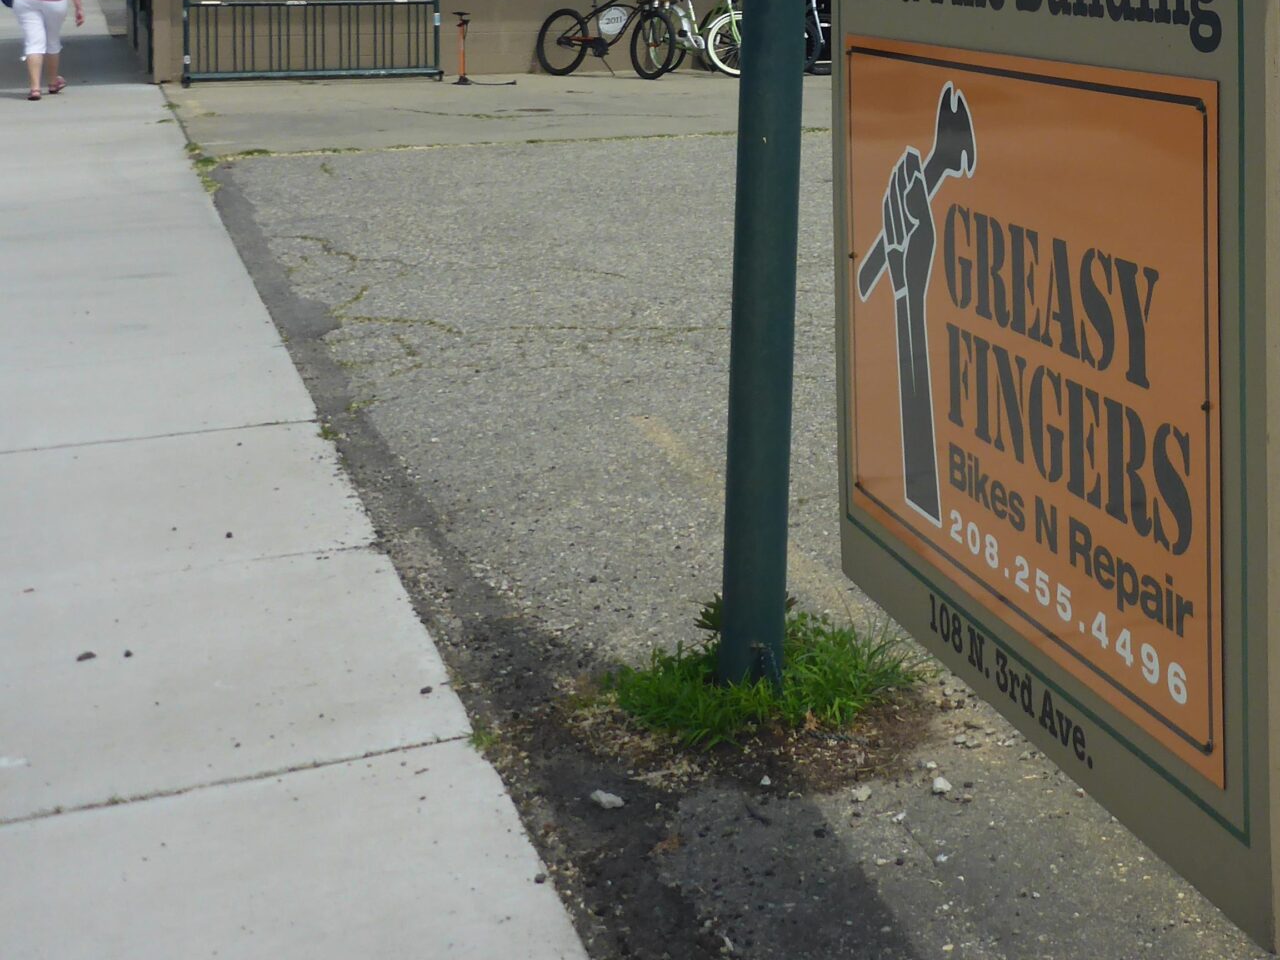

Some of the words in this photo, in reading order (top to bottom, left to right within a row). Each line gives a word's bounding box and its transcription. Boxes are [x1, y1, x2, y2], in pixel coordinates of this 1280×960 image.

[943, 203, 1160, 390] GREASY
[946, 321, 1193, 556] FINGERS
[949, 442, 1026, 532] Bikes
[1035, 495, 1058, 554] N
[1069, 516, 1194, 638] Repair
[949, 509, 1188, 705] 208.255.4496
[929, 593, 963, 654] 108
[967, 623, 990, 680] N.
[995, 647, 1036, 719] 3rd
[1038, 688, 1094, 770] Ave.
